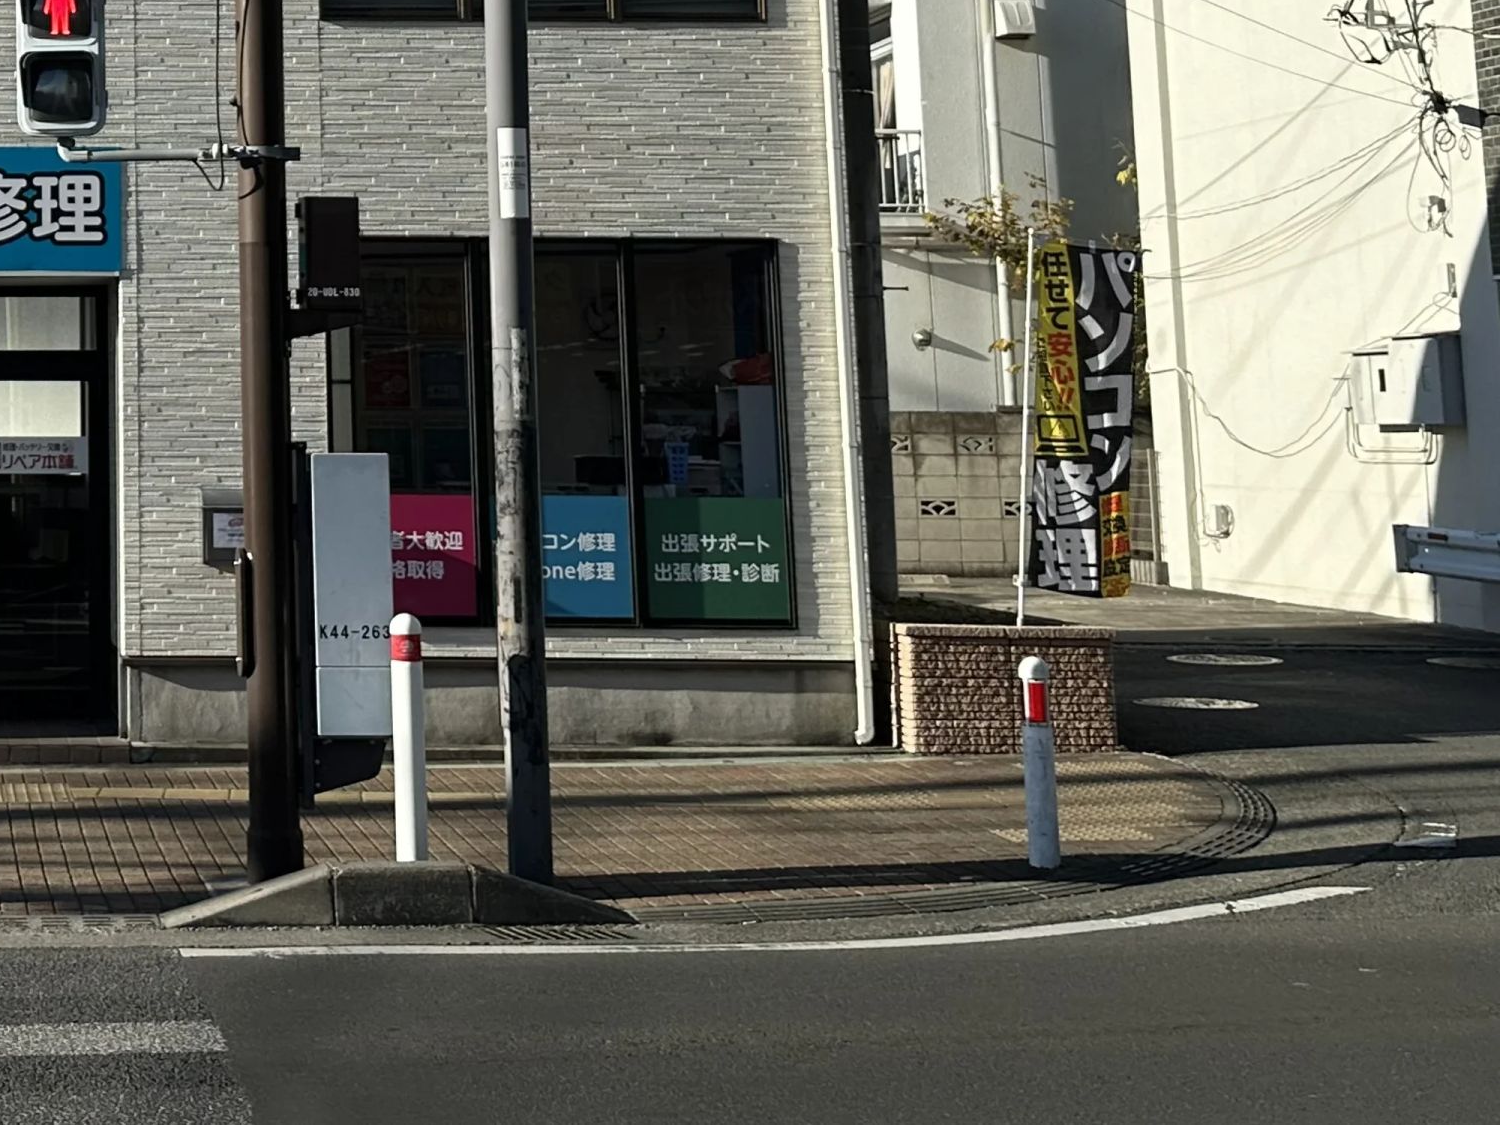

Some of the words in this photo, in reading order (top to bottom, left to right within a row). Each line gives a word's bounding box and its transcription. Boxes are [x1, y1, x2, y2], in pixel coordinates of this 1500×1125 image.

[1075, 251, 1137, 493] パソコン
[662, 533, 771, 553] 出張サポート
[1034, 458, 1099, 592] 修理
